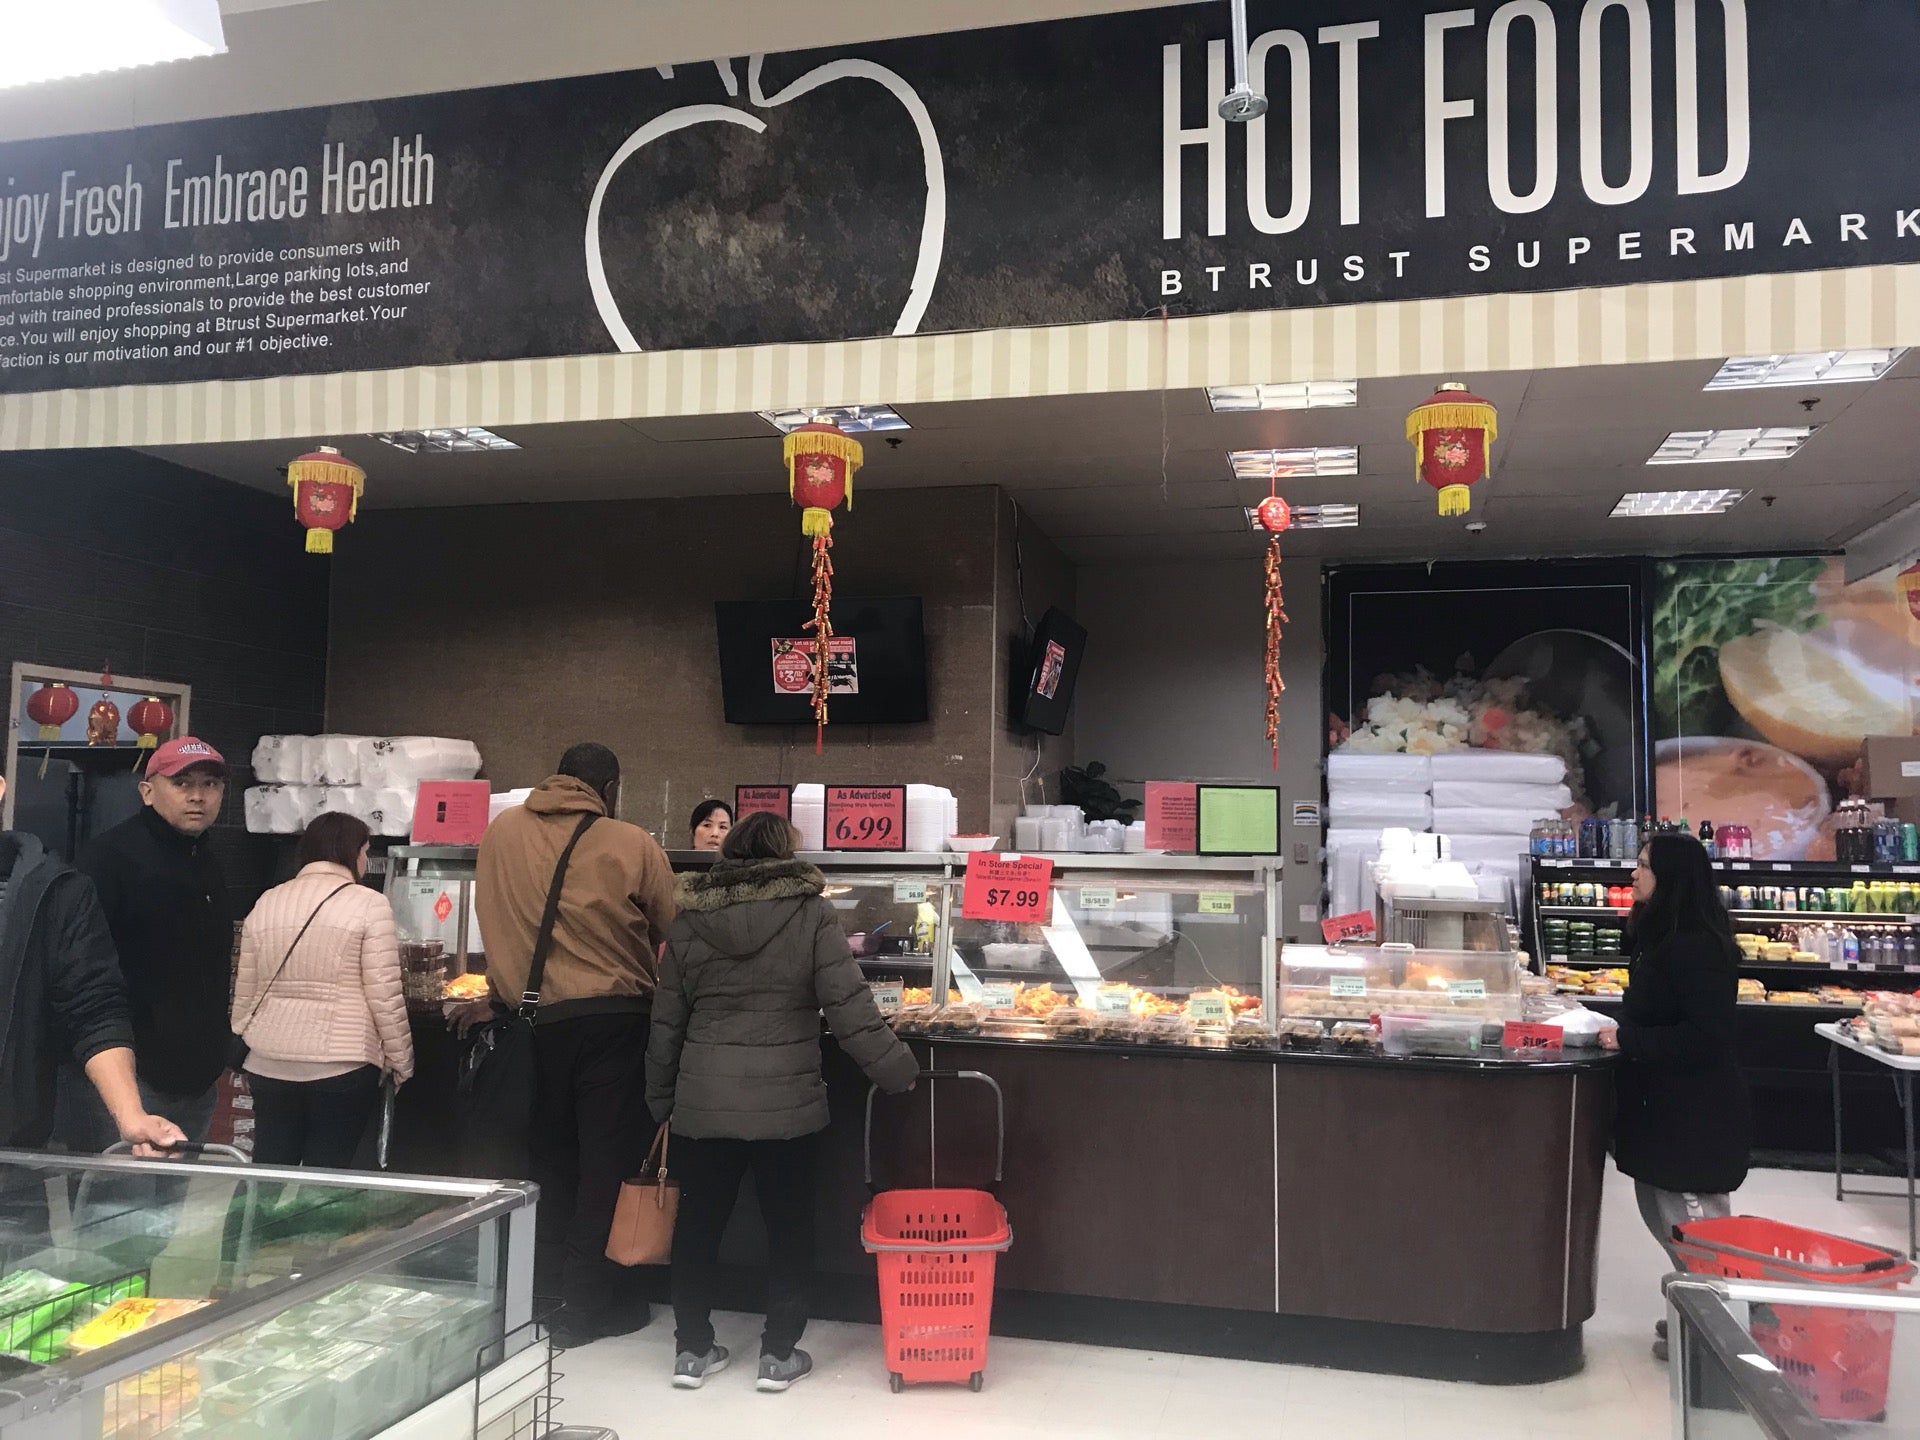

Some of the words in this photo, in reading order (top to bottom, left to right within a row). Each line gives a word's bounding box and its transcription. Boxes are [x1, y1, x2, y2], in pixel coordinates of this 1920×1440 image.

[1162, 20, 1380, 240] HOT
[1424, 0, 1750, 219] FOOD
[0, 176, 49, 261] joy
[58, 164, 142, 239] Fresh
[164, 155, 308, 229] Embrace
[321, 134, 434, 215] Health
[16, 262, 106, 284] Supermarket
[111, 260, 122, 274] is
[127, 254, 194, 274] designed
[200, 254, 213, 267] to
[218, 248, 274, 269] provide
[279, 241, 364, 261] consumers
[369, 236, 400, 253] with
[1160, 251, 1411, 296] BTRUST
[1468, 208, 1920, 273] SUPERMARK
[68, 281, 133, 299] shopping
[284, 264, 341, 285] parking
[19, 309, 47, 324] with
[52, 304, 100, 321] trained
[106, 297, 205, 321] professionals
[209, 297, 223, 310] to
[228, 291, 285, 312] provide
[290, 289, 314, 304] the
[319, 286, 353, 302] best
[357, 281, 431, 299] customer
[52, 327, 75, 343] will
[80, 325, 119, 344] enjoy
[123, 320, 191, 340] shopping
[196, 319, 210, 333] at
[215, 315, 260, 332] Btrust
[48, 350, 60, 365] is
[65, 350, 88, 364] our
[93, 345, 168, 362] motivation
[173, 341, 201, 357] and
[206, 341, 231, 355] our
[235, 337, 253, 352] #1
[259, 331, 333, 353] objective.
[837, 790, 847, 799] As
[849, 790, 892, 799] Advertised
[835, 816, 892, 841] 6.99
[978, 859, 986, 867] In
[989, 860, 1010, 868] Store
[1012, 861, 1043, 870] Special
[986, 888, 1039, 907] $7.99
